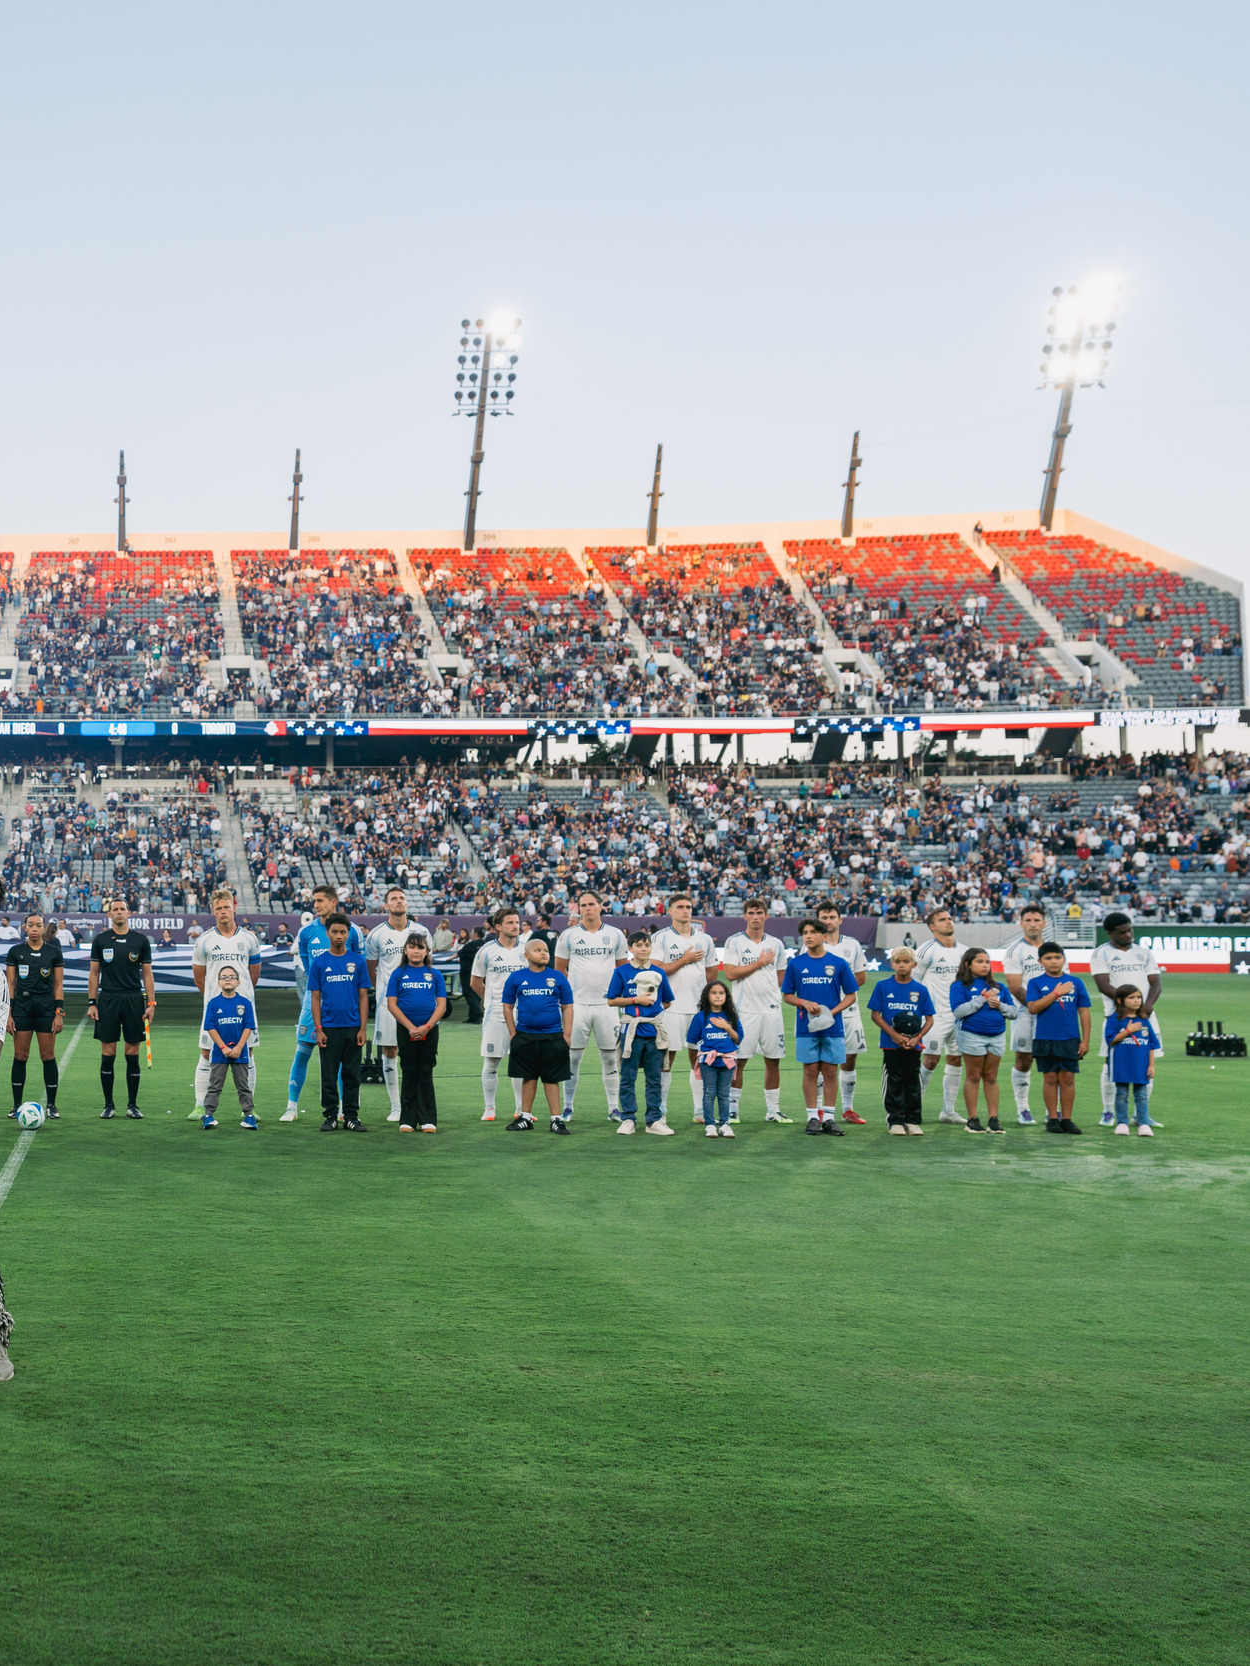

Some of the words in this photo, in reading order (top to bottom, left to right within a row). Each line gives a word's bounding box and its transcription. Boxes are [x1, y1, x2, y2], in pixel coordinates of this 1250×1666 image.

[11, 722, 36, 735] DIEGO
[58, 722, 65, 735] 0
[171, 722, 178, 735] 0
[200, 722, 236, 735] TORONTO
[65, 917, 103, 925] Snapdragon
[153, 917, 184, 929] FIELD
[386, 946, 404, 956] DIRE
[574, 947, 614, 957] DIRECTV
[211, 953, 246, 962] DIRECTV
[935, 966, 959, 974] DIREC
[1024, 964, 1045, 972] DIRE
[326, 974, 354, 983] DIRECTV
[402, 982, 432, 990] DIRECTV
[522, 988, 554, 996] DIRECTV
[888, 1002, 918, 1011] DIRECTV
[218, 1017, 243, 1025] DIRECTV
[706, 1032, 728, 1040] DIREC
[778, 1034, 785, 1048] 3
